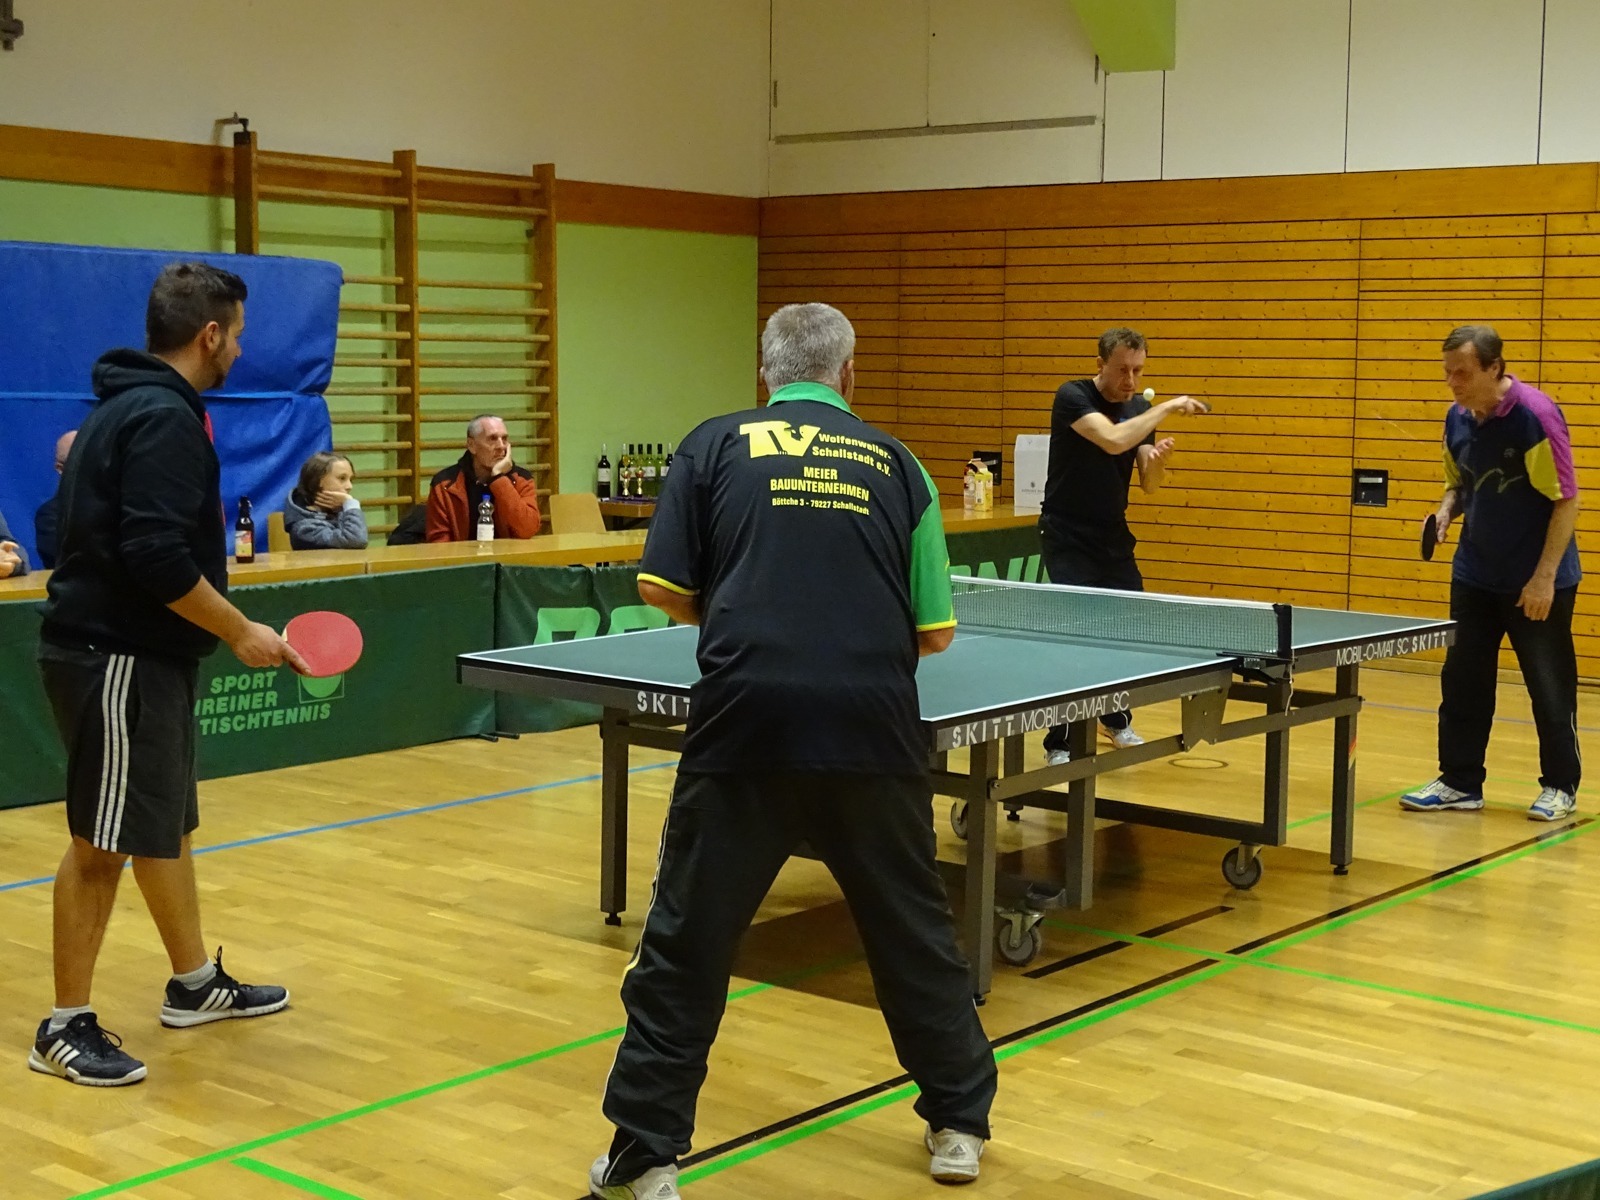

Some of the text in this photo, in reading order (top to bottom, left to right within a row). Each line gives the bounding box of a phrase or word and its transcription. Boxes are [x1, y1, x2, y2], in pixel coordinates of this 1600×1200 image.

[739, 420, 821, 458] TV
[818, 432, 892, 460] Wolfenweiler-
[803, 466, 838, 480] MEIER
[812, 446, 891, 477] Schallstadt e.V.
[770, 479, 870, 502] BAUUNTERNEHMEN
[799, 498, 805, 506] 3
[810, 500, 831, 509] 79227
[832, 501, 870, 516] Schallstadt
[1336, 631, 1447, 666] MOBIL-O-MAT SC SKITT
[210, 671, 278, 694] SPORT
[194, 690, 278, 717] REINER
[637, 690, 691, 718] SKIT
[199, 703, 331, 735] TISCHTENNIS
[952, 690, 1130, 748] SKITT MOBIL-O-MAT SC
